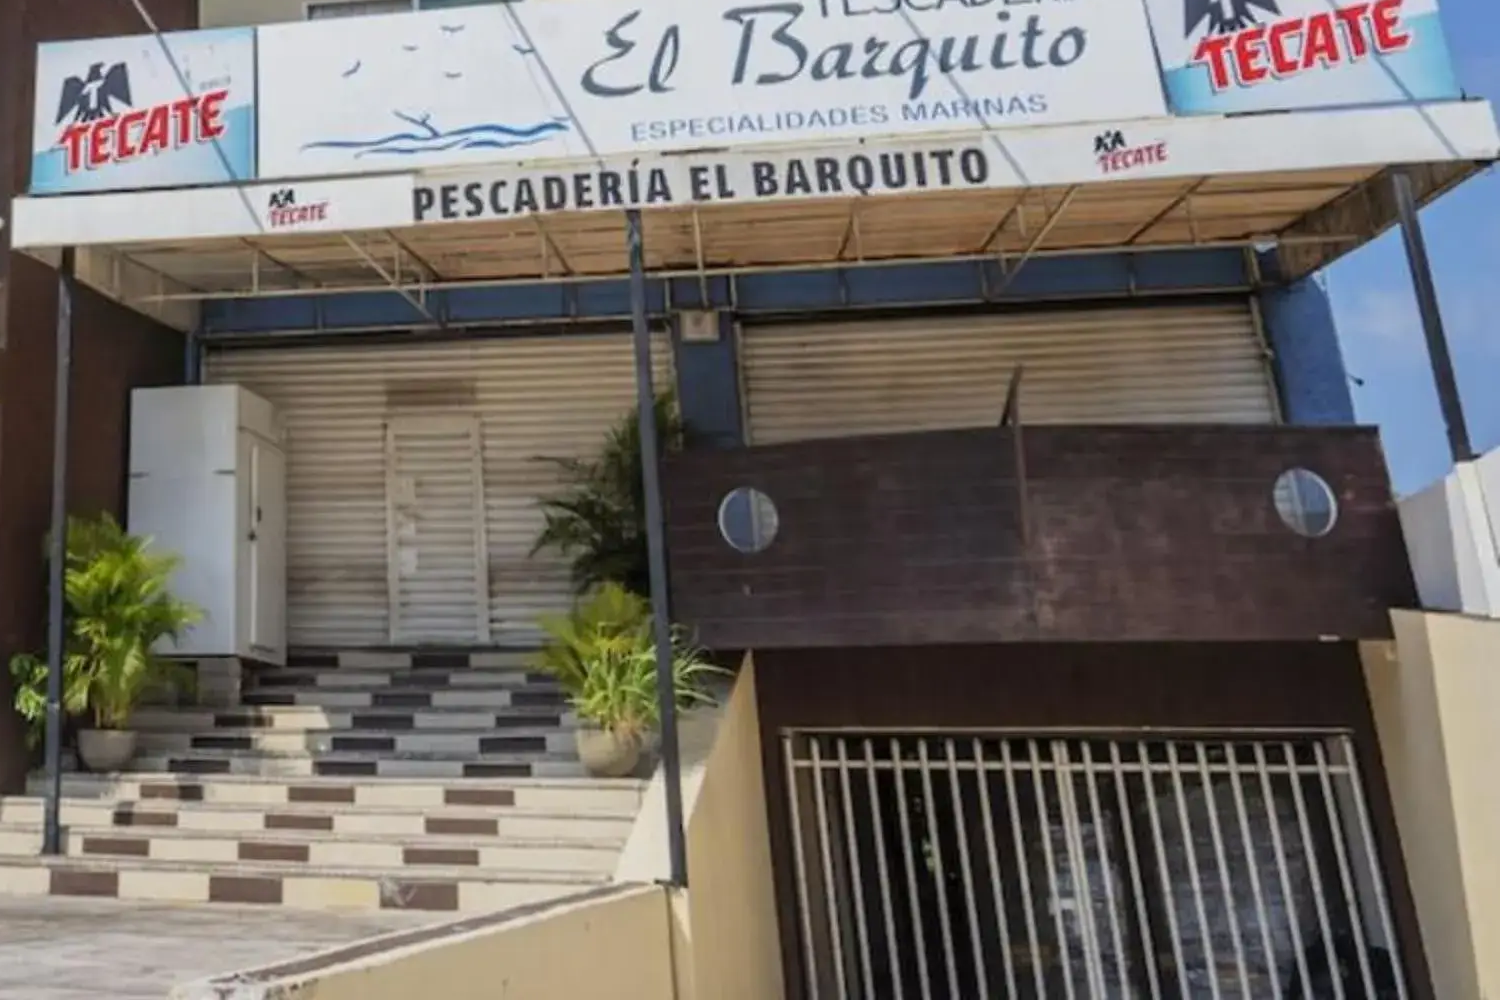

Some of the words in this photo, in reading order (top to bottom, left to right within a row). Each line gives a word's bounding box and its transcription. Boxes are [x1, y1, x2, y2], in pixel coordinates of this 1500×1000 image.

[580, 9, 680, 98] El
[722, 2, 1088, 100] Barquito
[55, 88, 232, 176] TECATE
[630, 104, 890, 144] ESPECIALIDADES
[901, 93, 1049, 122] MARINAS
[412, 158, 673, 222] PESCADERÍA
[689, 163, 736, 200] EL
[753, 147, 990, 198] BARQUITO
[1097, 142, 1168, 174] TECATE
[268, 201, 330, 229] TECATE
